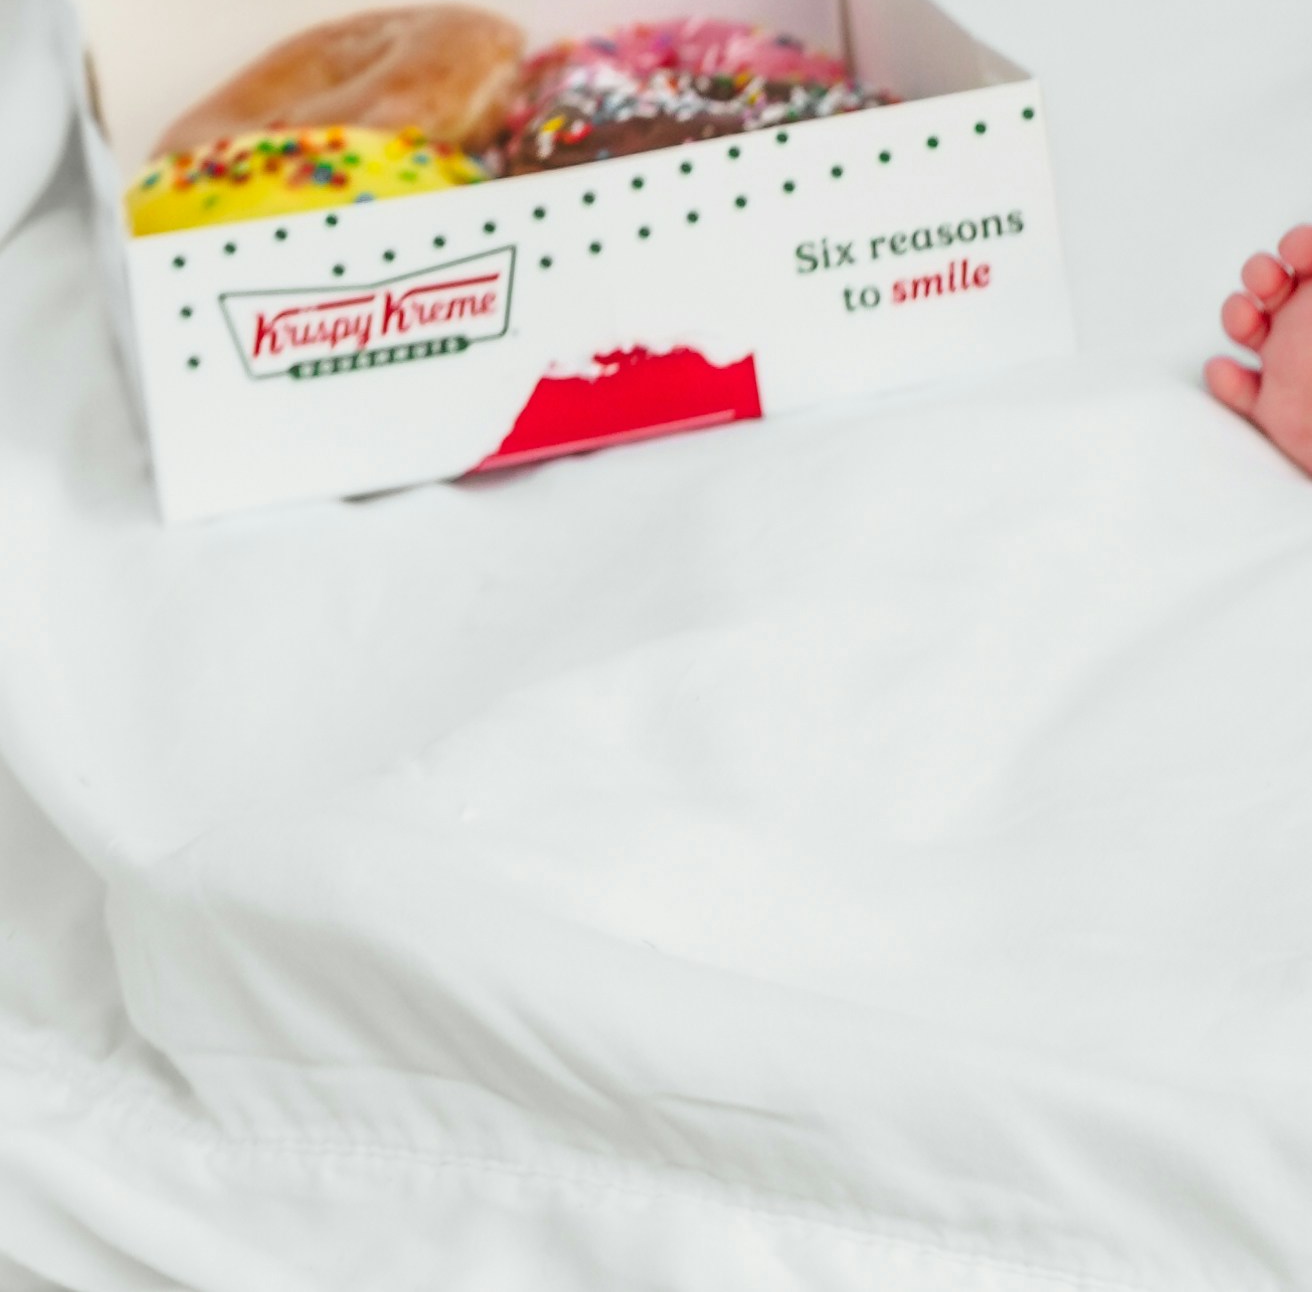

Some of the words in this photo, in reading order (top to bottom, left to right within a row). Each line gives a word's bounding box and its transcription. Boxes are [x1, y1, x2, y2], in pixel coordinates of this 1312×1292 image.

[794, 238, 856, 275] Six
[869, 210, 1025, 261] reasons
[252, 292, 377, 360] Krispy
[380, 271, 501, 338] Kreme
[842, 285, 882, 313] to
[891, 258, 991, 304] smile
